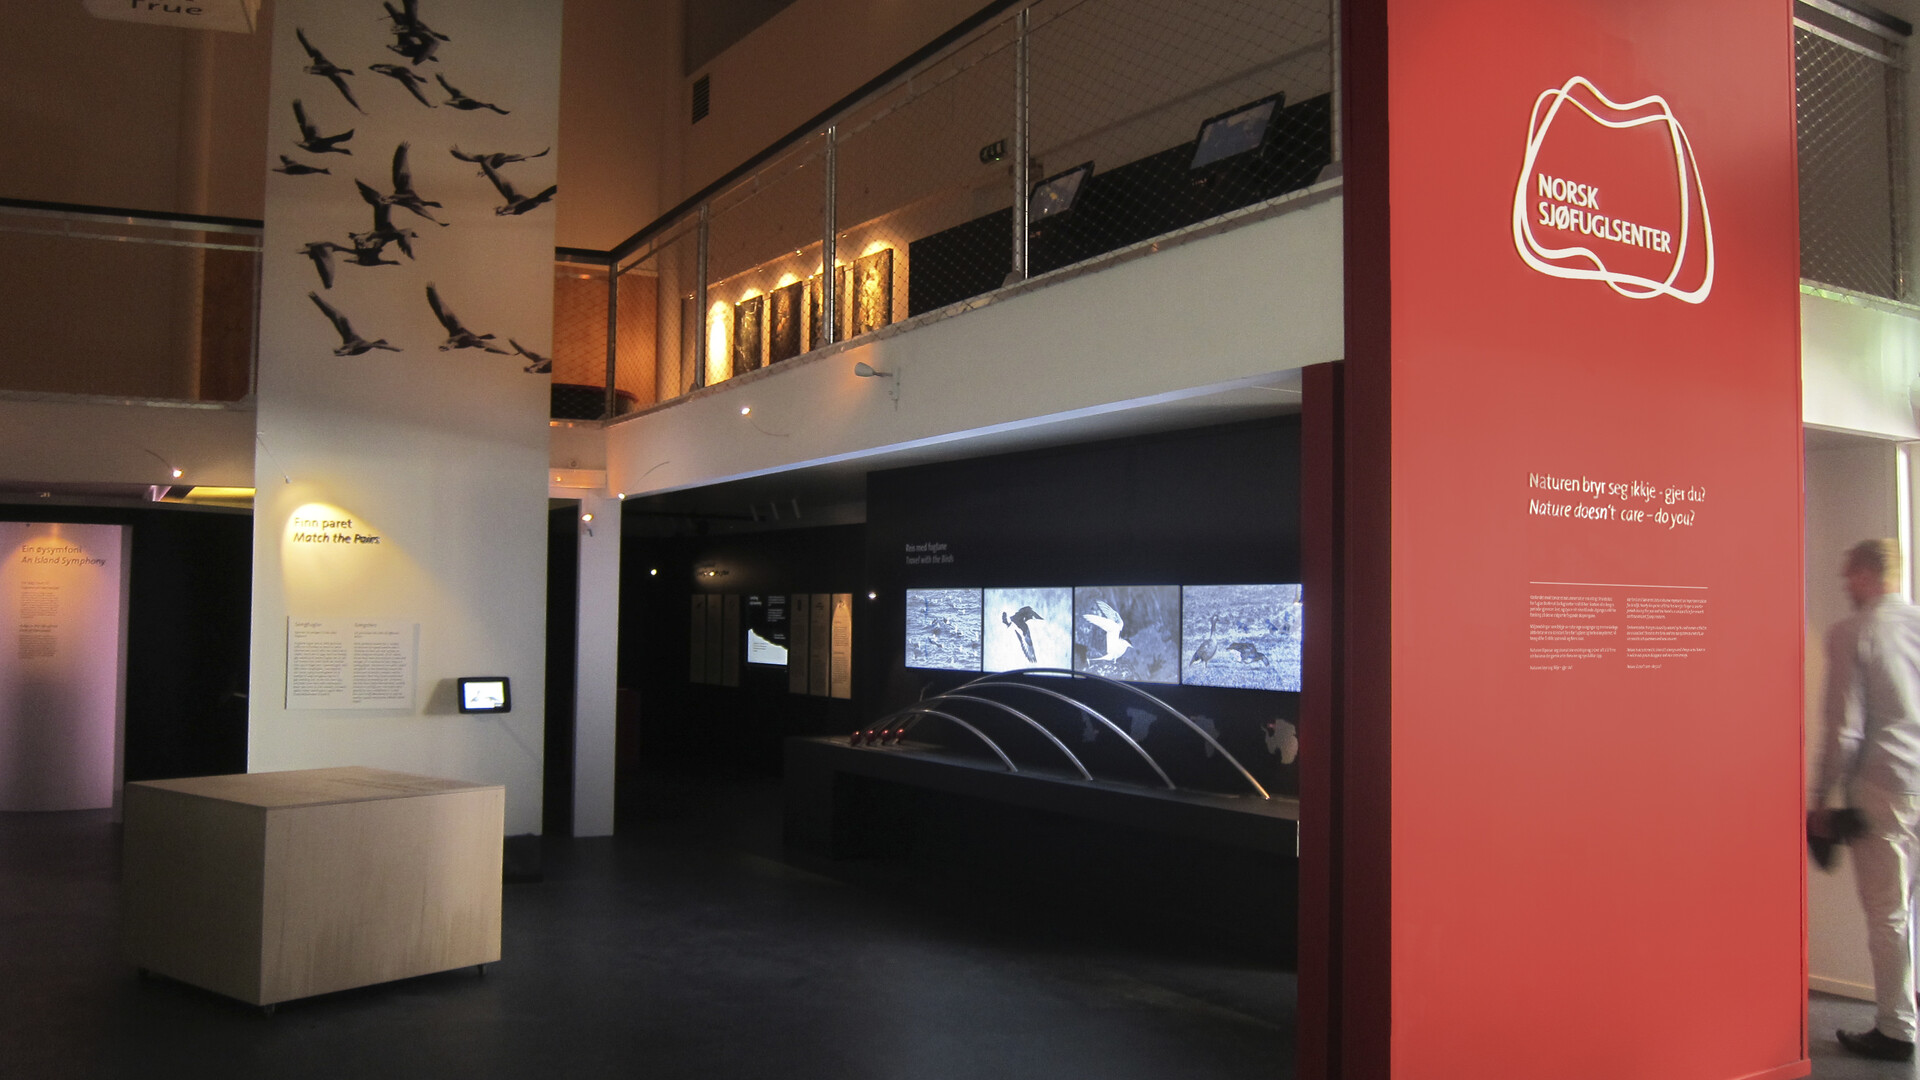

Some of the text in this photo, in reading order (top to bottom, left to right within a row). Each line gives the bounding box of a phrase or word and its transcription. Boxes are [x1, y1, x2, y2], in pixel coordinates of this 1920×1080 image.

[1538, 173, 1600, 210] NORSK
[1538, 201, 1671, 254] SJØFUGLSENTER
[1529, 473, 1579, 492] Naturen
[1582, 476, 1605, 499] bryr
[1608, 482, 1628, 500] seg
[1630, 481, 1656, 502] ikkje
[1664, 486, 1685, 505] gjer
[1687, 486, 1706, 502] du?
[294, 517, 352, 530] Finn paret
[1529, 499, 1571, 517] Nature
[1620, 509, 1644, 523] care
[1654, 508, 1669, 524] do
[1670, 510, 1696, 530] you?
[22, 545, 36, 553] Ein
[293, 533, 380, 544] Match the Pairs
[21, 556, 106, 567] An Island Symphony
